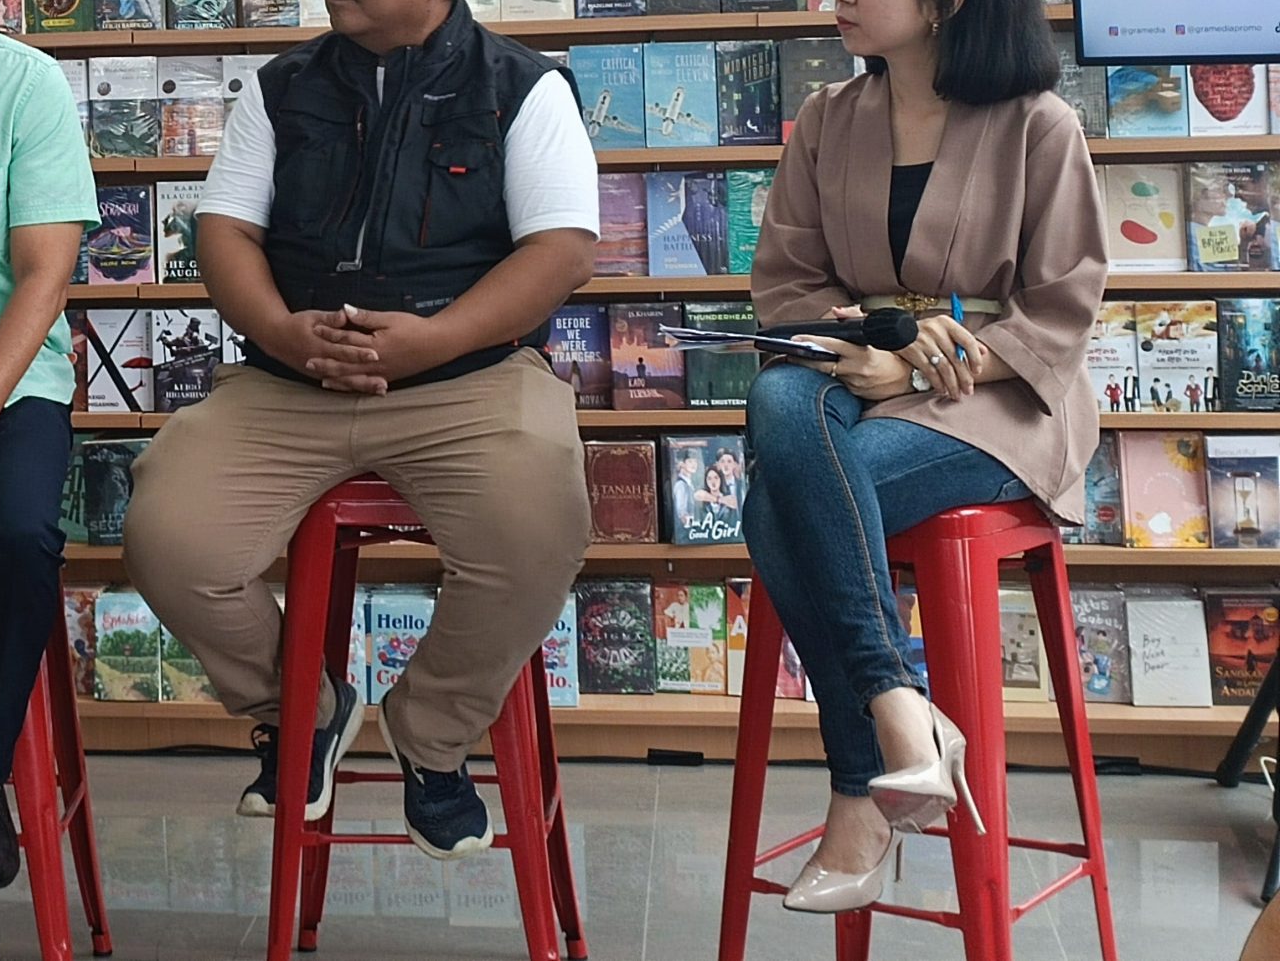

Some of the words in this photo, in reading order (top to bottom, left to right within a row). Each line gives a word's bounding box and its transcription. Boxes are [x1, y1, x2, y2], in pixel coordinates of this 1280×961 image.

[1120, 24, 1167, 36] @gramedia
[1187, 23, 1264, 35] @gramediapromo
[601, 57, 638, 72] CRITICAL
[675, 53, 711, 69] CRITICAL
[603, 71, 637, 86] ELEVEN
[676, 68, 710, 83] ELEVEN
[556, 317, 591, 329] BEFORE
[687, 313, 754, 322] THUNDERHEAD
[566, 329, 581, 340] WE
[561, 340, 587, 352] WERE
[1241, 370, 1279, 383] Dunia
[174, 383, 202, 391] KEIGO
[166, 390, 212, 400] HIGASHINO
[711, 398, 748, 406] SHUSTERM
[600, 484, 642, 495] TANAH
[701, 511, 713, 530] A
[710, 520, 742, 540] Girl
